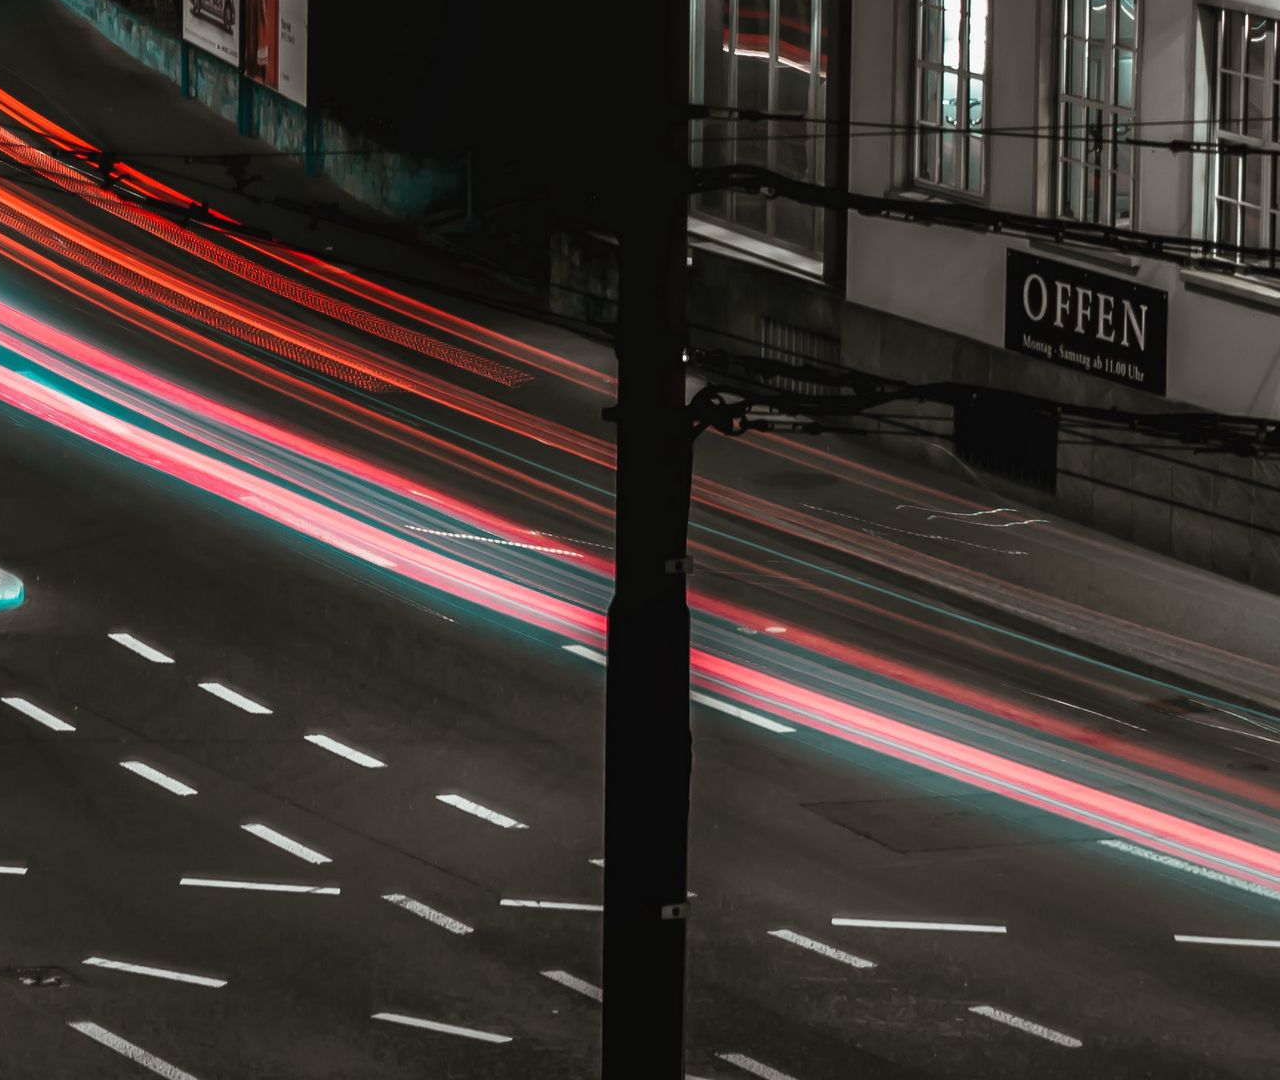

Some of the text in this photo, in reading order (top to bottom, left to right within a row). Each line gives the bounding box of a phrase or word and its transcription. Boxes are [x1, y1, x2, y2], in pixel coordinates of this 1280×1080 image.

[1022, 273, 1148, 353] OFFEN
[1022, 332, 1053, 360] Montag
[1058, 343, 1091, 370] Samstag
[1092, 355, 1103, 370] ab
[1104, 356, 1126, 378] 11.00
[1127, 364, 1145, 383] Uhr
